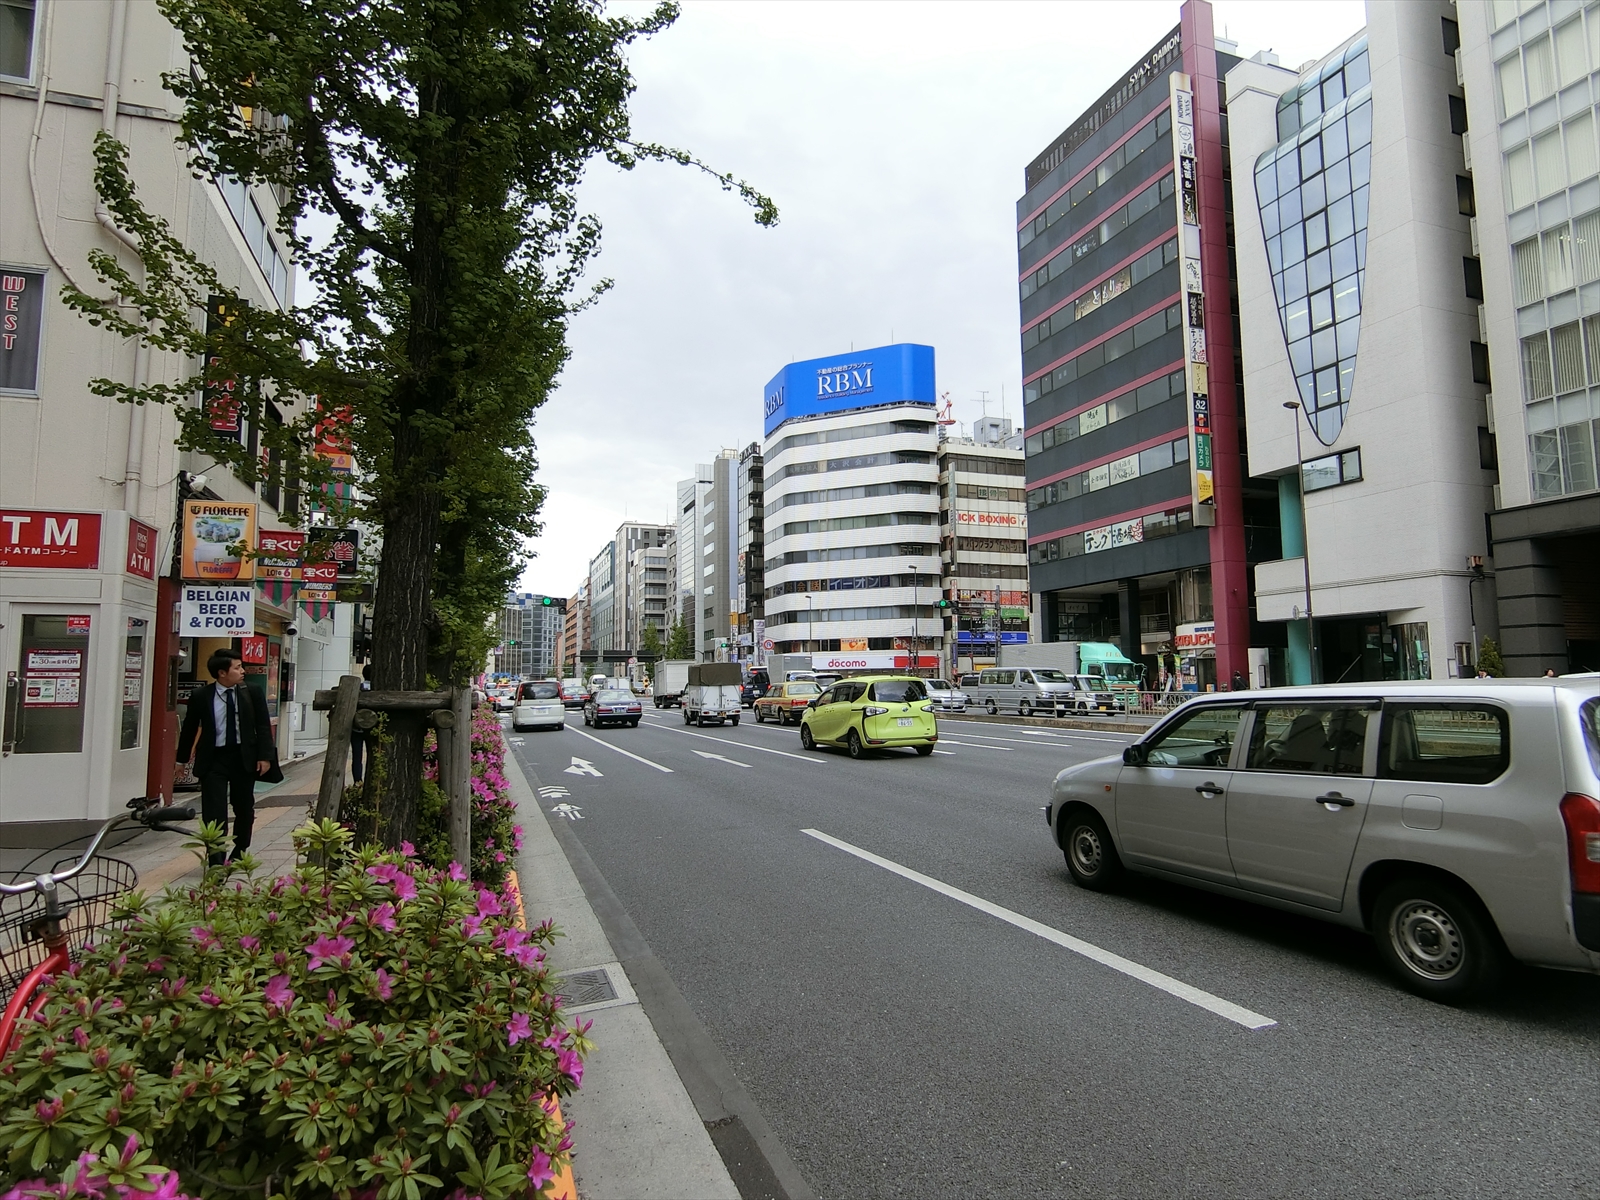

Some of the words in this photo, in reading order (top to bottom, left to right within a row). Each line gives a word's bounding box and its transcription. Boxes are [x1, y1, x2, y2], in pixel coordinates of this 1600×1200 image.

[1130, 59, 1151, 85] SVAX
[1152, 32, 1180, 65] DAIMON
[3, 275, 26, 350] WEST
[817, 367, 874, 396] RBM
[764, 386, 785, 420] RBM
[1195, 400, 1206, 410] 82
[829, 457, 875, 470] 大沢会計
[203, 506, 250, 517] FLOREFFE
[979, 515, 1017, 525] BOXING
[0, 545, 78, 556] ドATMコーナー
[262, 539, 302, 552] 宝くじ
[130, 552, 151, 573] ATM
[284, 568, 291, 577] 6
[303, 567, 336, 578] 宝くじ
[830, 576, 879, 590] イーオン
[186, 590, 251, 602] BELGIAN
[321, 591, 328, 599] 6
[199, 603, 237, 615] BEER
[189, 616, 202, 628] &
[205, 616, 246, 628] FOOD
[828, 658, 867, 668] docomo
